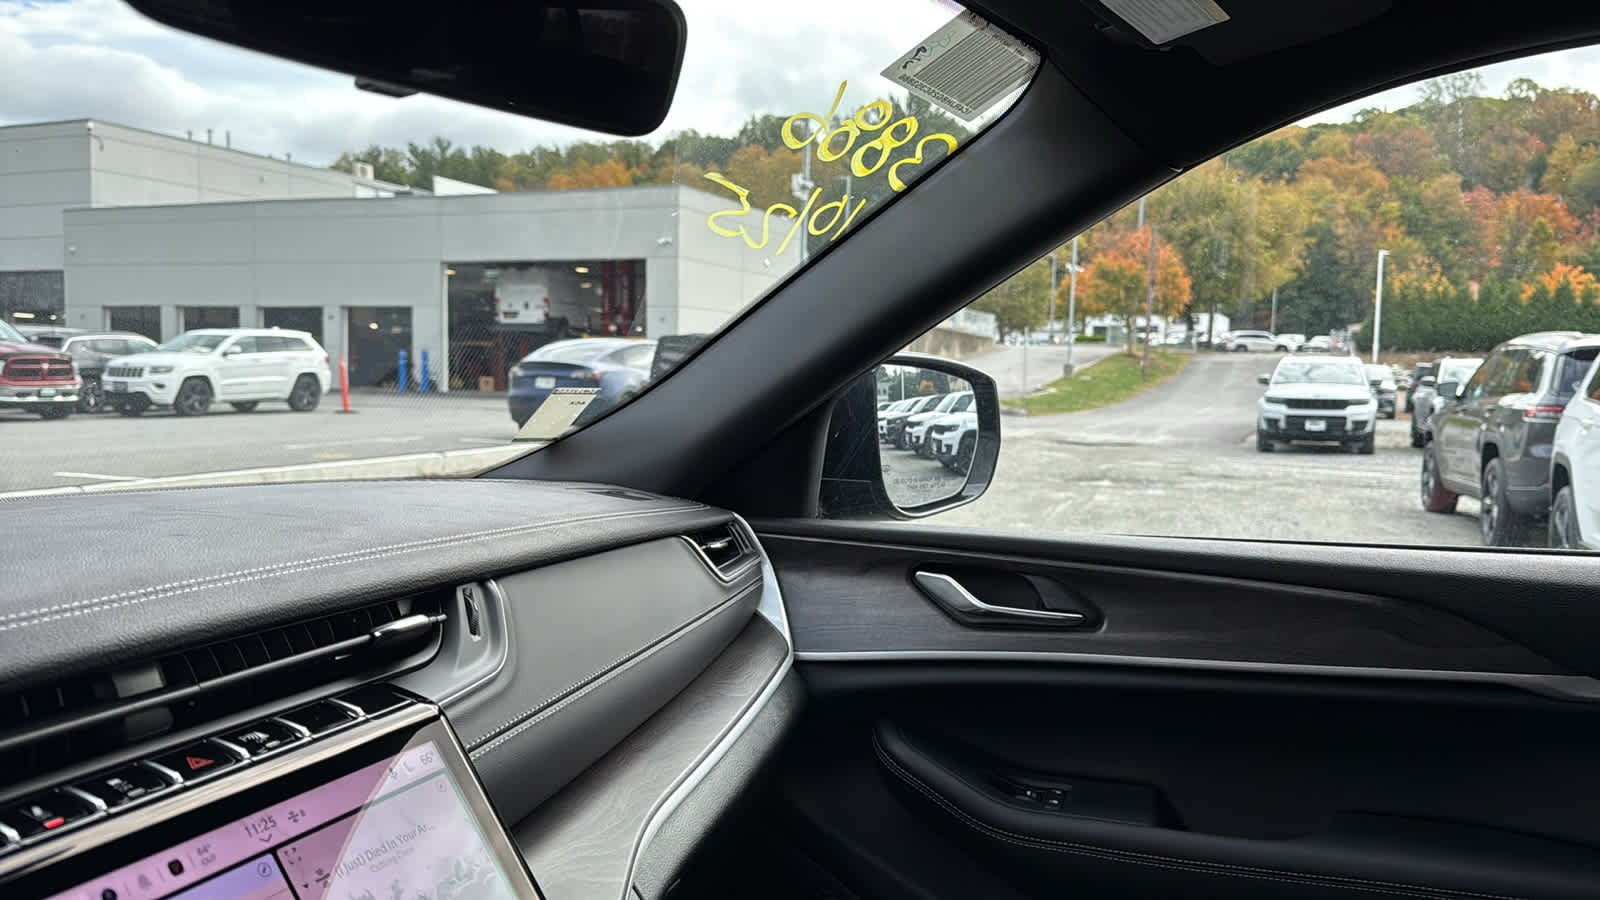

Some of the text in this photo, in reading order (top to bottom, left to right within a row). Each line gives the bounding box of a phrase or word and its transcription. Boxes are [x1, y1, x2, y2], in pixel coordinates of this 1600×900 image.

[243, 814, 278, 839] 11:25
[365, 843, 388, 861] Died
[396, 830, 416, 846] Your
